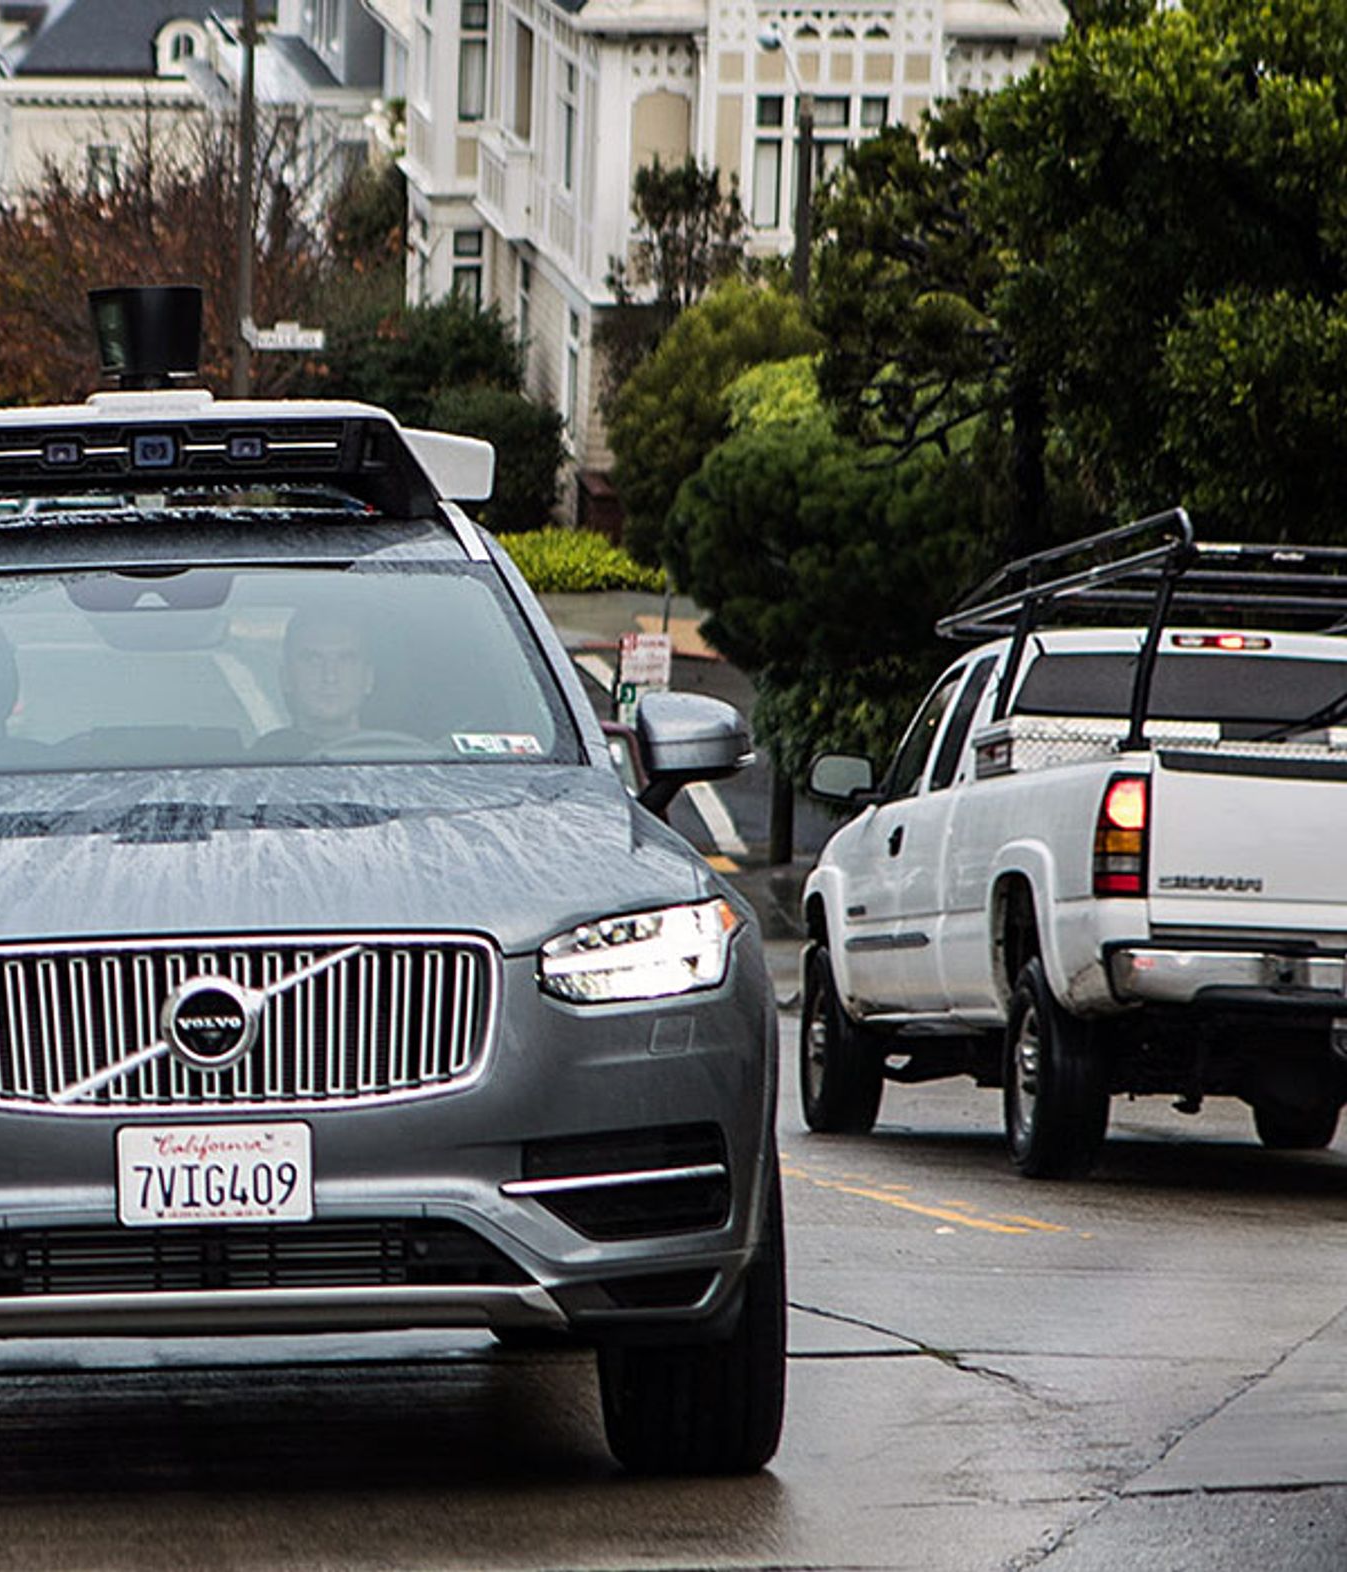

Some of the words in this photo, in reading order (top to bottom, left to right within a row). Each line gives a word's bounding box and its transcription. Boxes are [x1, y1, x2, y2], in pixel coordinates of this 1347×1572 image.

[177, 1016, 242, 1030] VOLVO
[157, 1133, 268, 1160] California
[132, 1161, 298, 1209] 7VIG409
